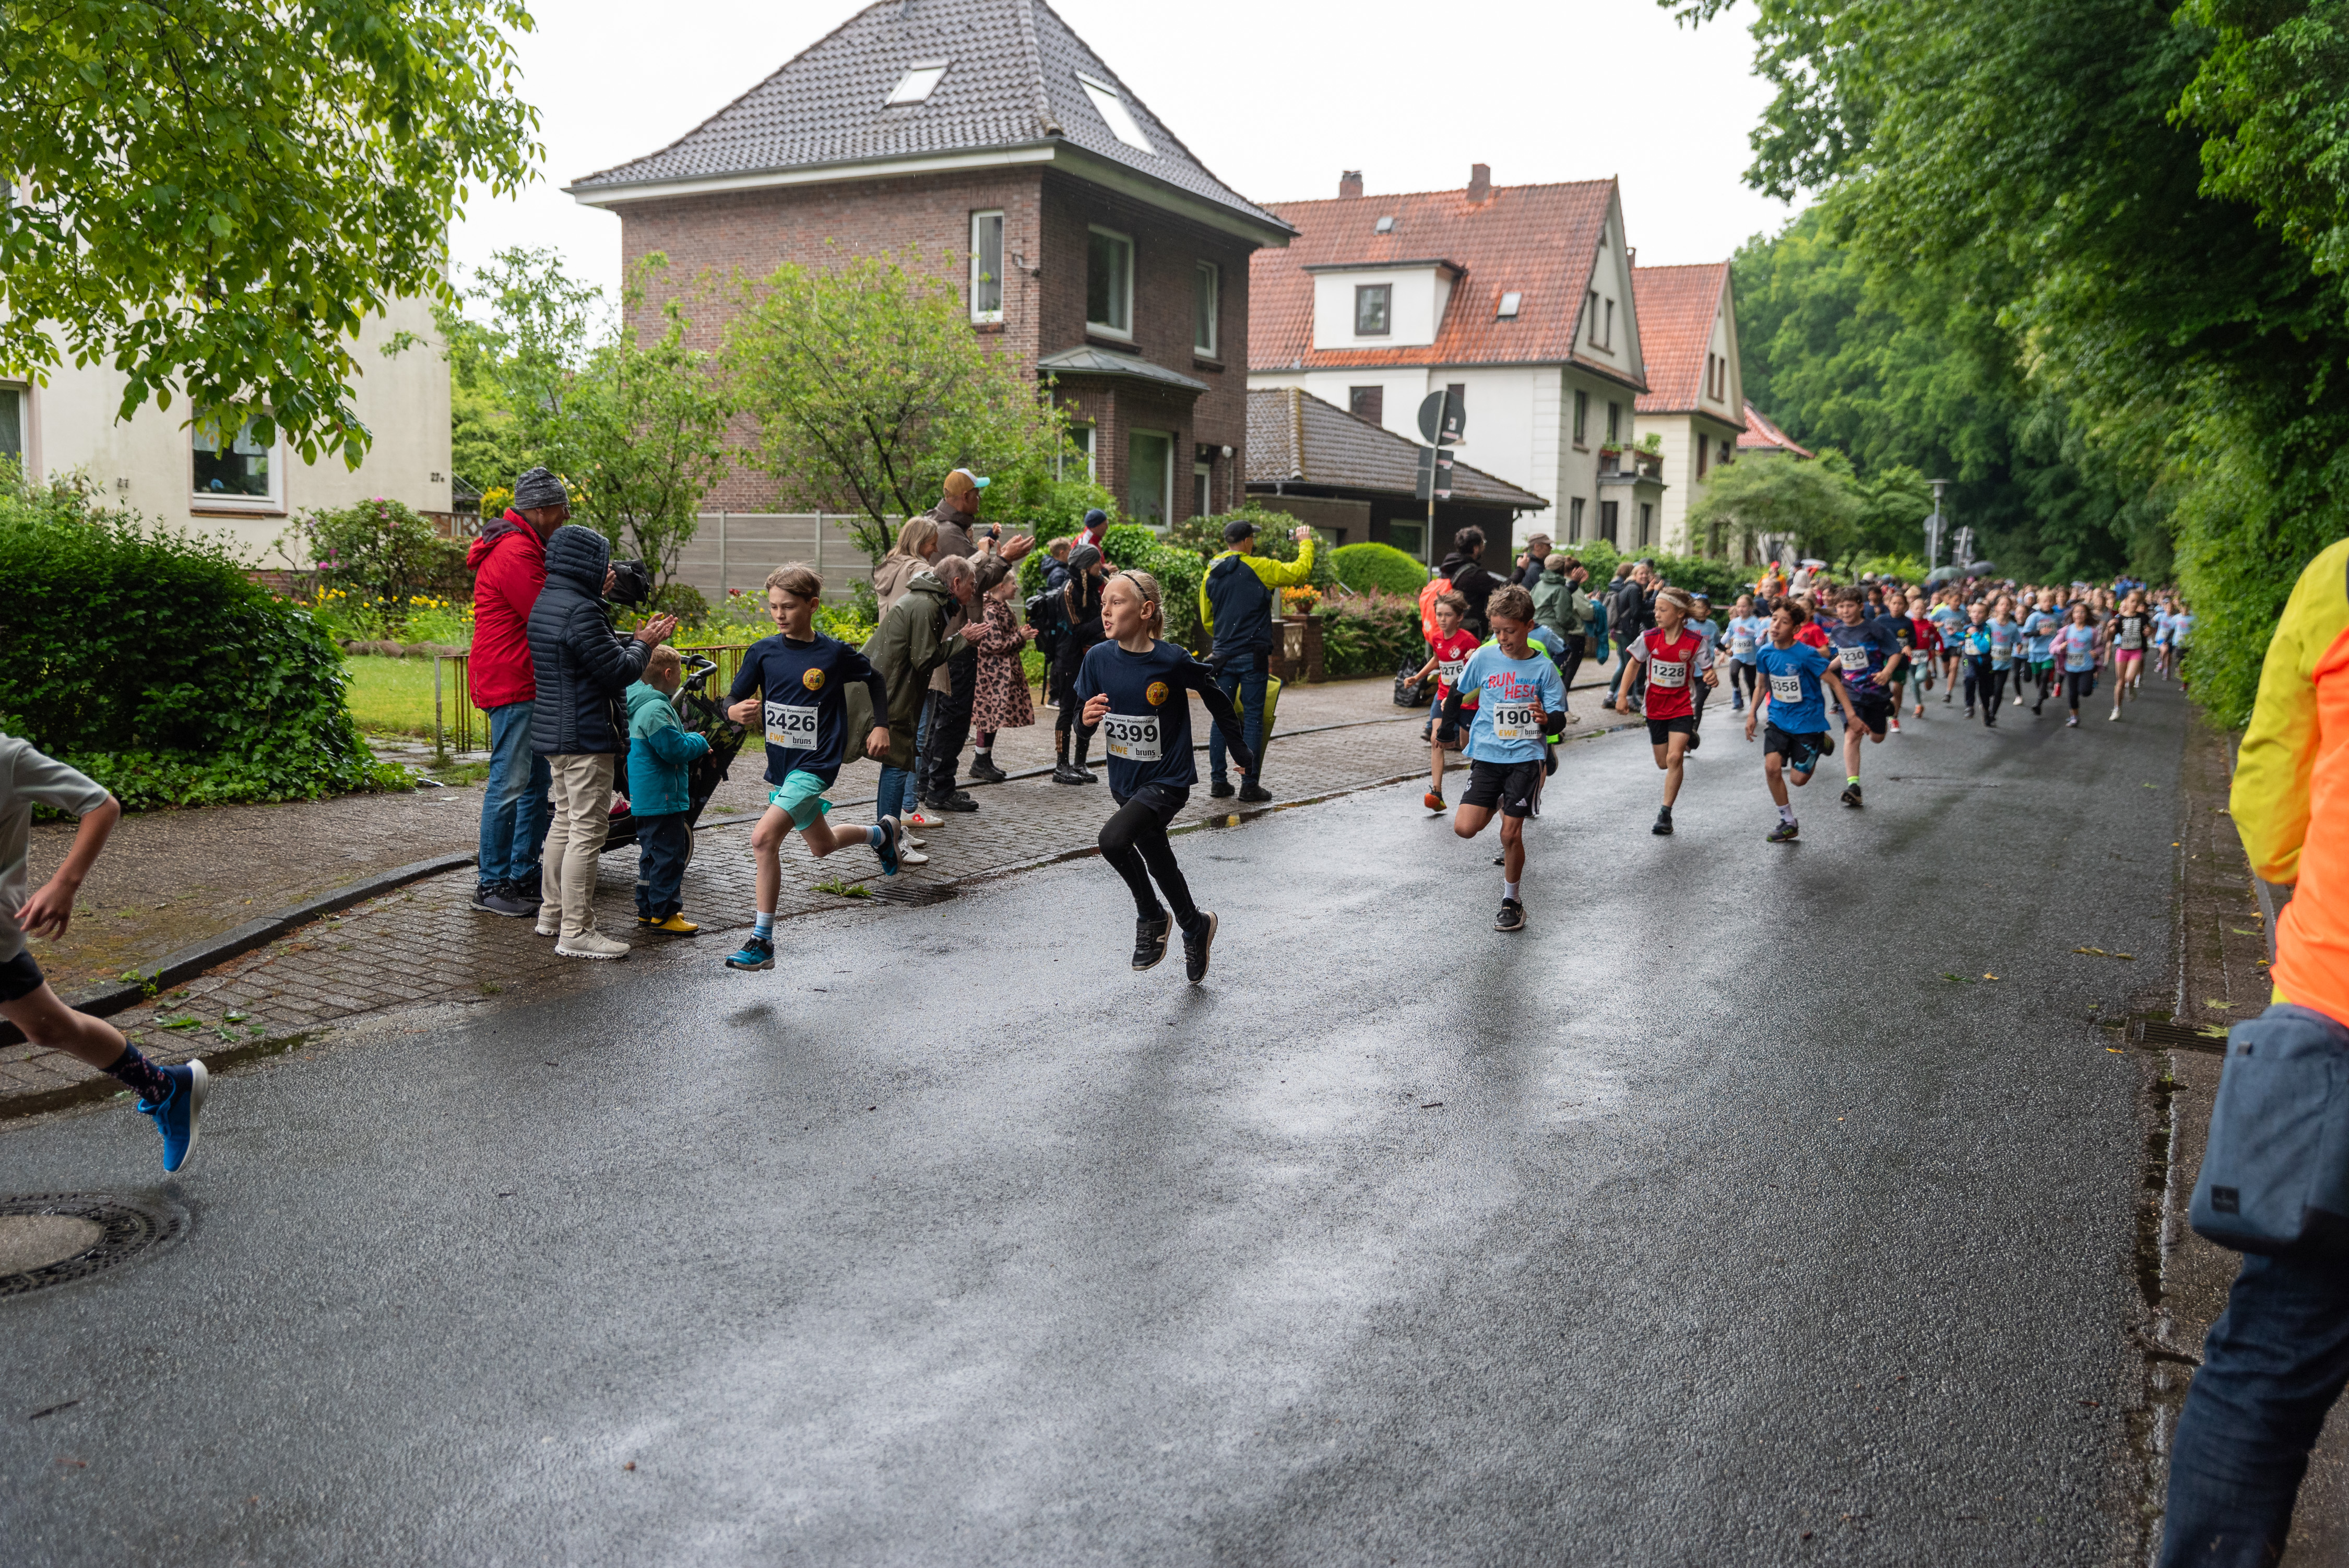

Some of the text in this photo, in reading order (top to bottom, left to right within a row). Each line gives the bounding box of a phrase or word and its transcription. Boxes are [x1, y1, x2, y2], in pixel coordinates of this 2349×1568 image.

[1653, 665, 1684, 677] 1228
[1771, 680, 1798, 692] 3358
[767, 710, 815, 732] 2426
[1105, 721, 1158, 742] 2399
[769, 732, 785, 743] EWE
[792, 736, 812, 744] bruns
[1111, 744, 1128, 755] EWE
[1135, 747, 1155, 756] bruns
